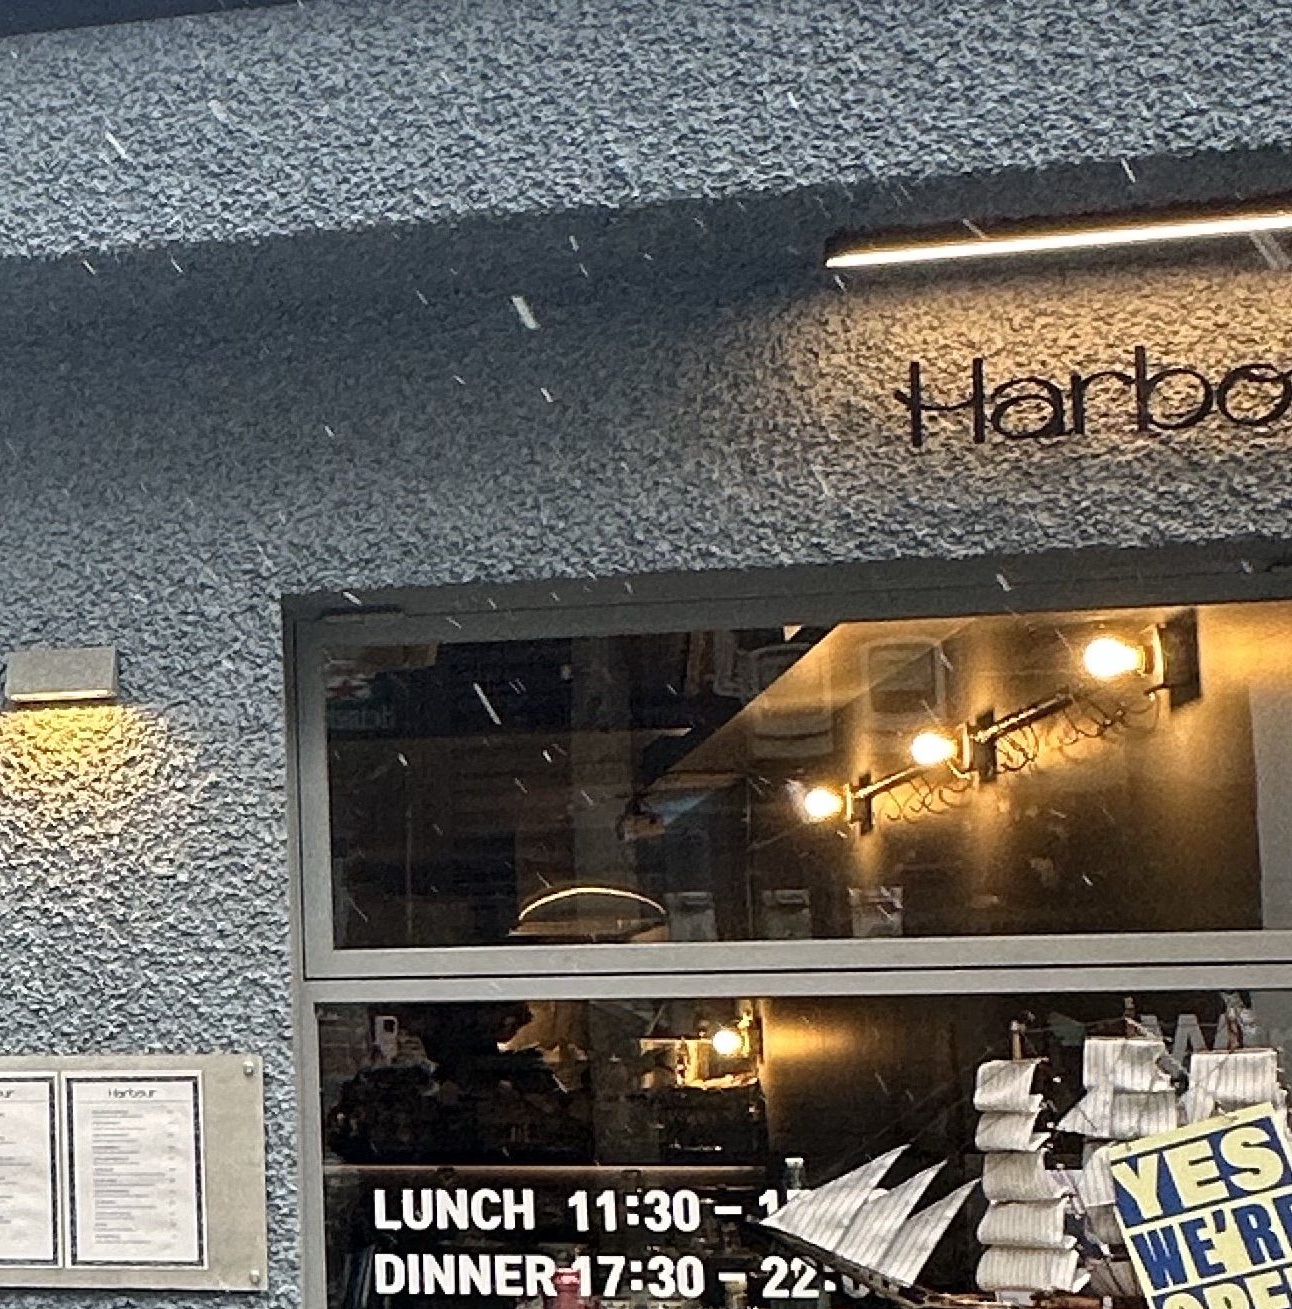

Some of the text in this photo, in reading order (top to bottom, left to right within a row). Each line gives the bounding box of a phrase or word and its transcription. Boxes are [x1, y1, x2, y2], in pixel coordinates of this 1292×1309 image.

[1110, 1125, 1285, 1221] YES
[374, 1187, 536, 1232] LUNCH
[568, 1188, 700, 1232] 11:30
[374, 1253, 556, 1297] DINNER
[575, 1255, 705, 1298] 17:30
